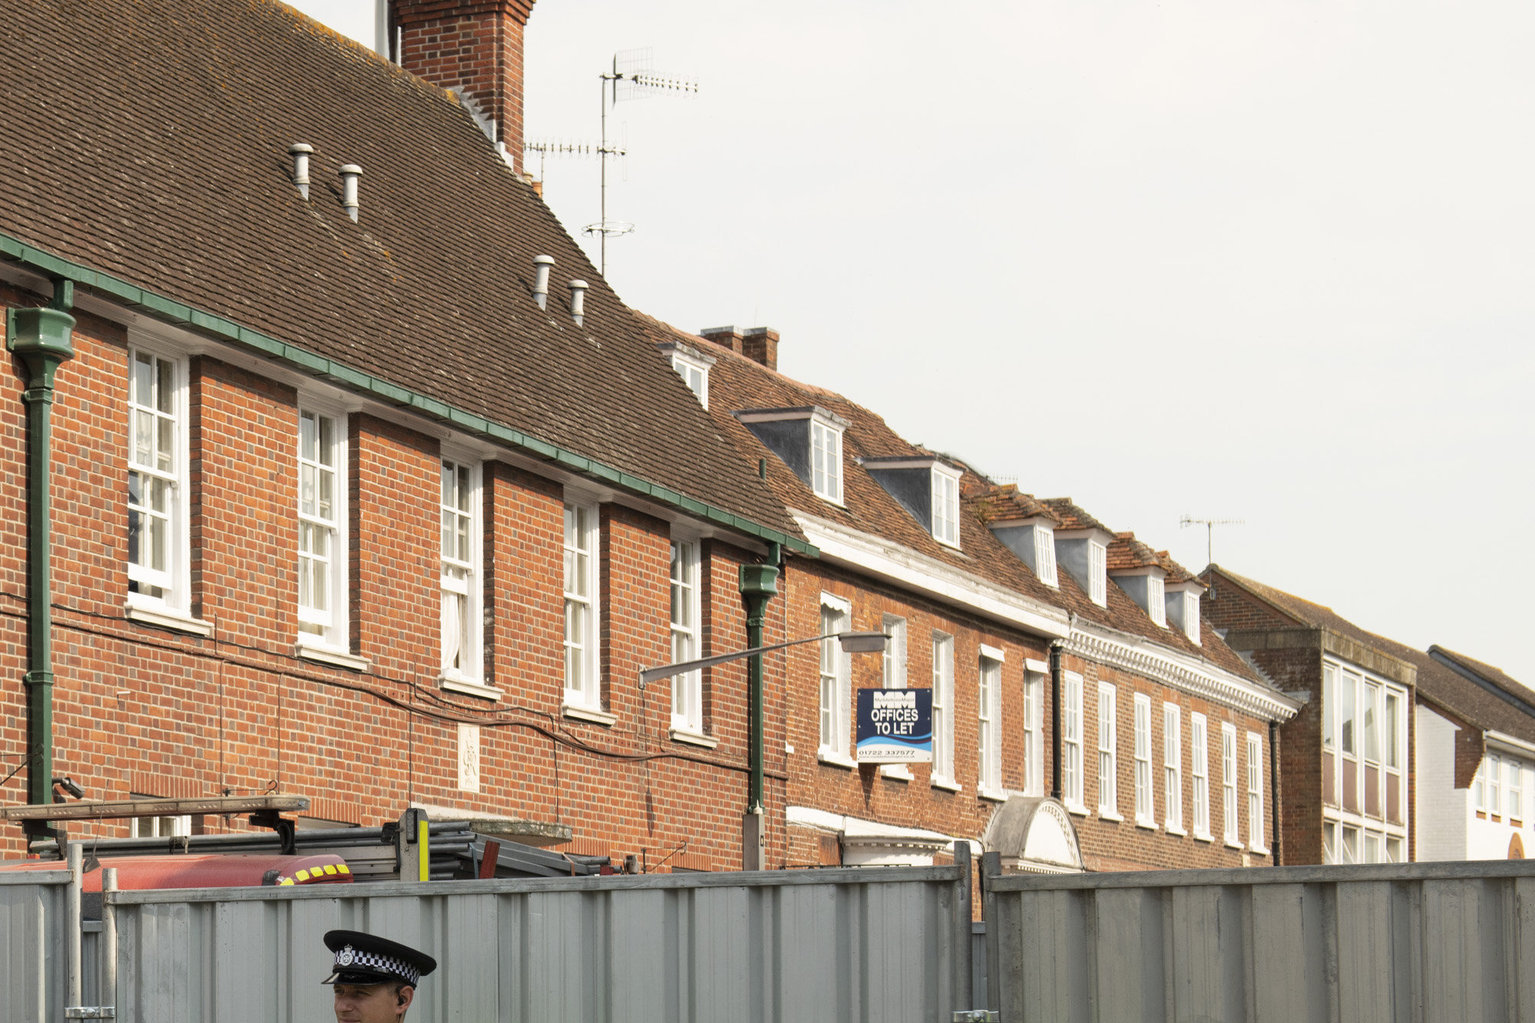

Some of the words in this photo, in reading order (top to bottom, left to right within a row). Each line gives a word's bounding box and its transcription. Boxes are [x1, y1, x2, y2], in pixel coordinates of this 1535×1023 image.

[871, 709, 918, 721] OFFICES
[875, 722, 891, 735] TO
[893, 722, 915, 735] LET
